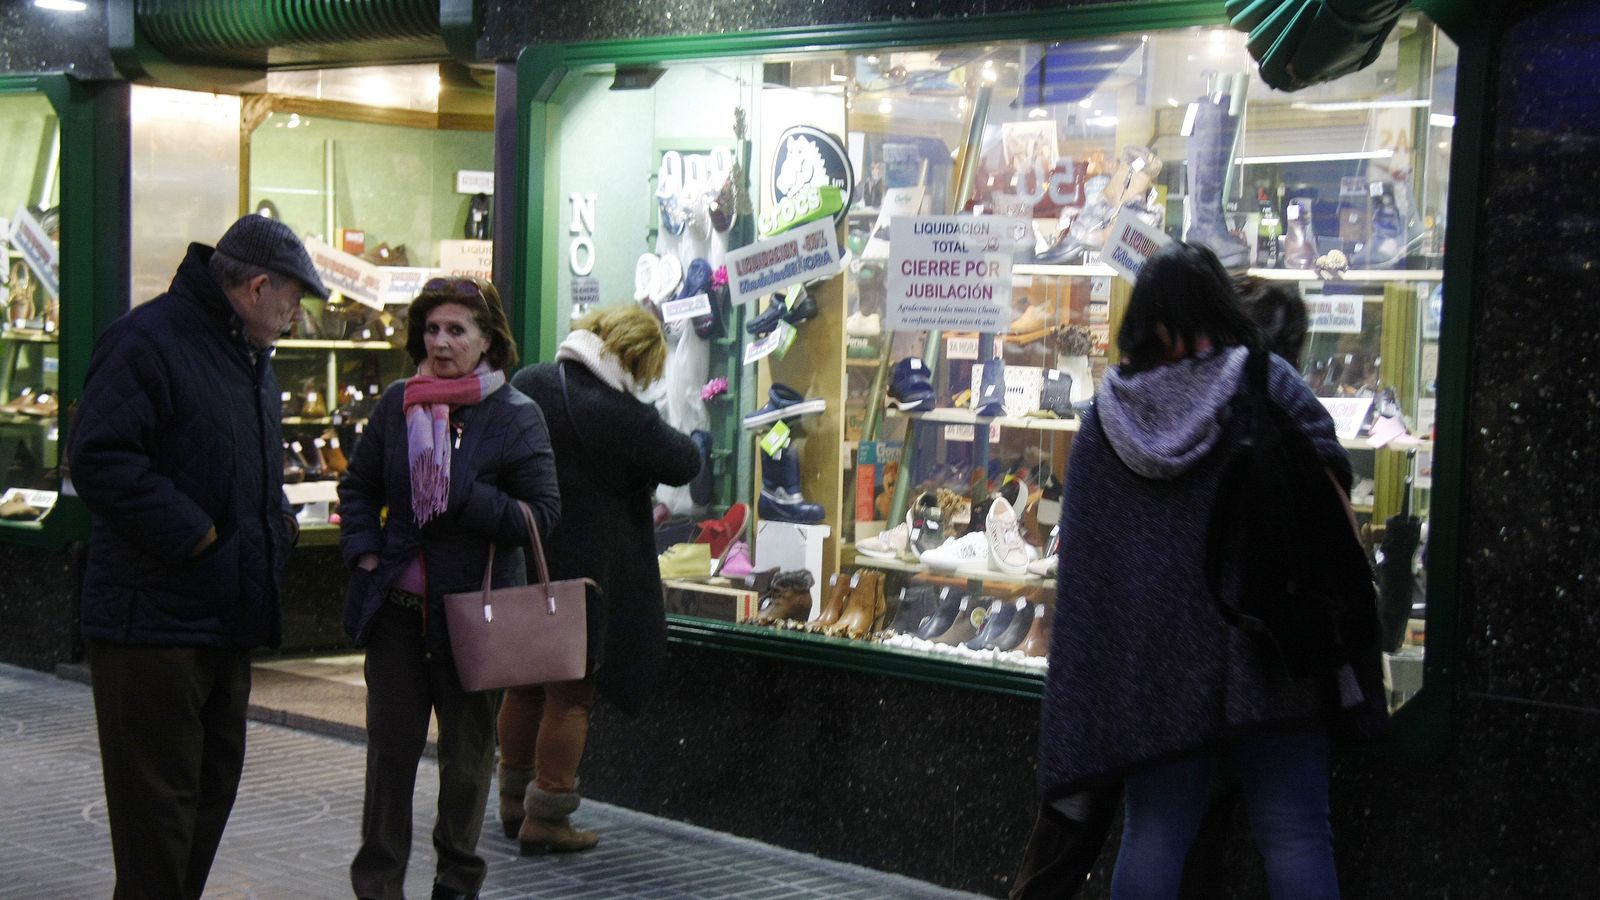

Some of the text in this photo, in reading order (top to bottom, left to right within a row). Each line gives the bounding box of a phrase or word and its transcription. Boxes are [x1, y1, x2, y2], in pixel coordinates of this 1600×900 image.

[758, 189, 822, 233] crocs
[932, 240, 969, 253] TOTAL
[901, 259, 1000, 278] CIERRE POR
[905, 283, 993, 300] JUBILACIÓN
